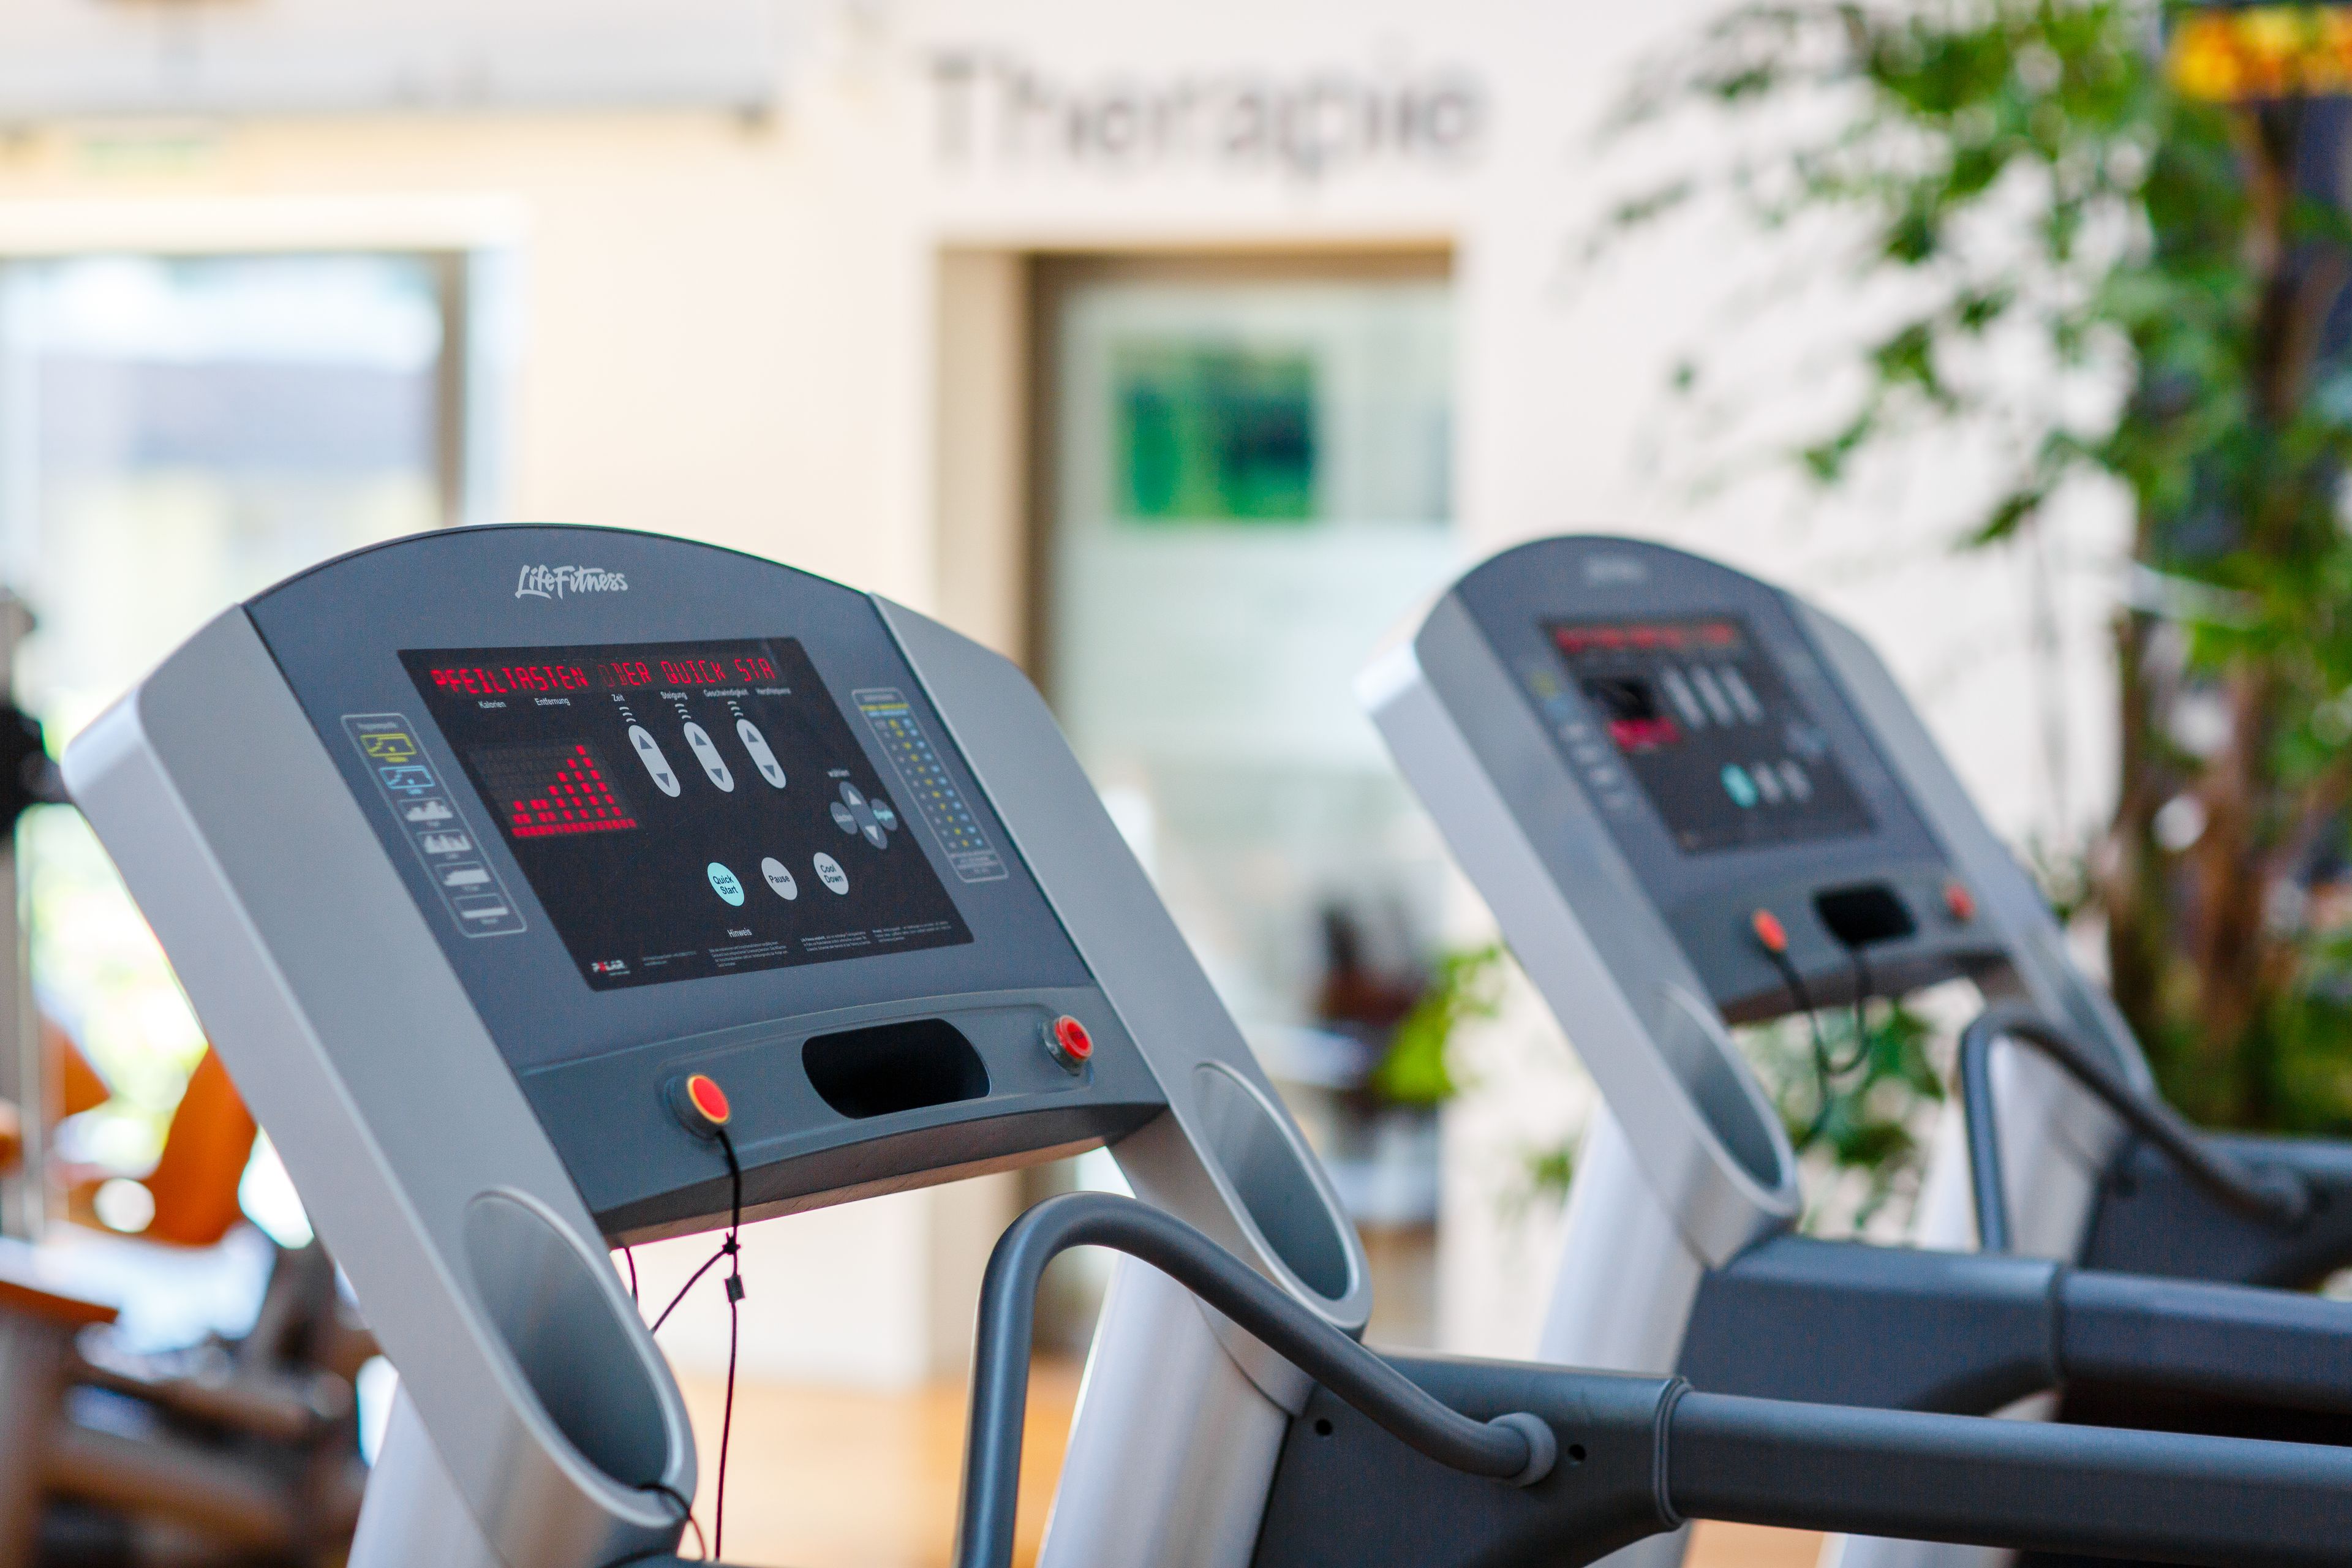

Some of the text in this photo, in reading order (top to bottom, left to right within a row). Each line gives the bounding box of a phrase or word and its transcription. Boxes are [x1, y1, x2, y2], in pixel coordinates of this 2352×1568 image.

[924, 49, 1491, 191] Therapie
[660, 660, 726, 684] QUICK
[734, 658, 775, 682] STA
[611, 693, 625, 702] Zeit
[660, 691, 688, 701] Steigung
[478, 700, 507, 709] Kalorien
[533, 697, 571, 706] Entfernung
[820, 864, 837, 873] Cool
[712, 875, 734, 884] Quick
[768, 875, 790, 884] Pause
[824, 875, 844, 884] Down
[719, 885, 739, 895] Start
[726, 927, 752, 938] Hinweis
